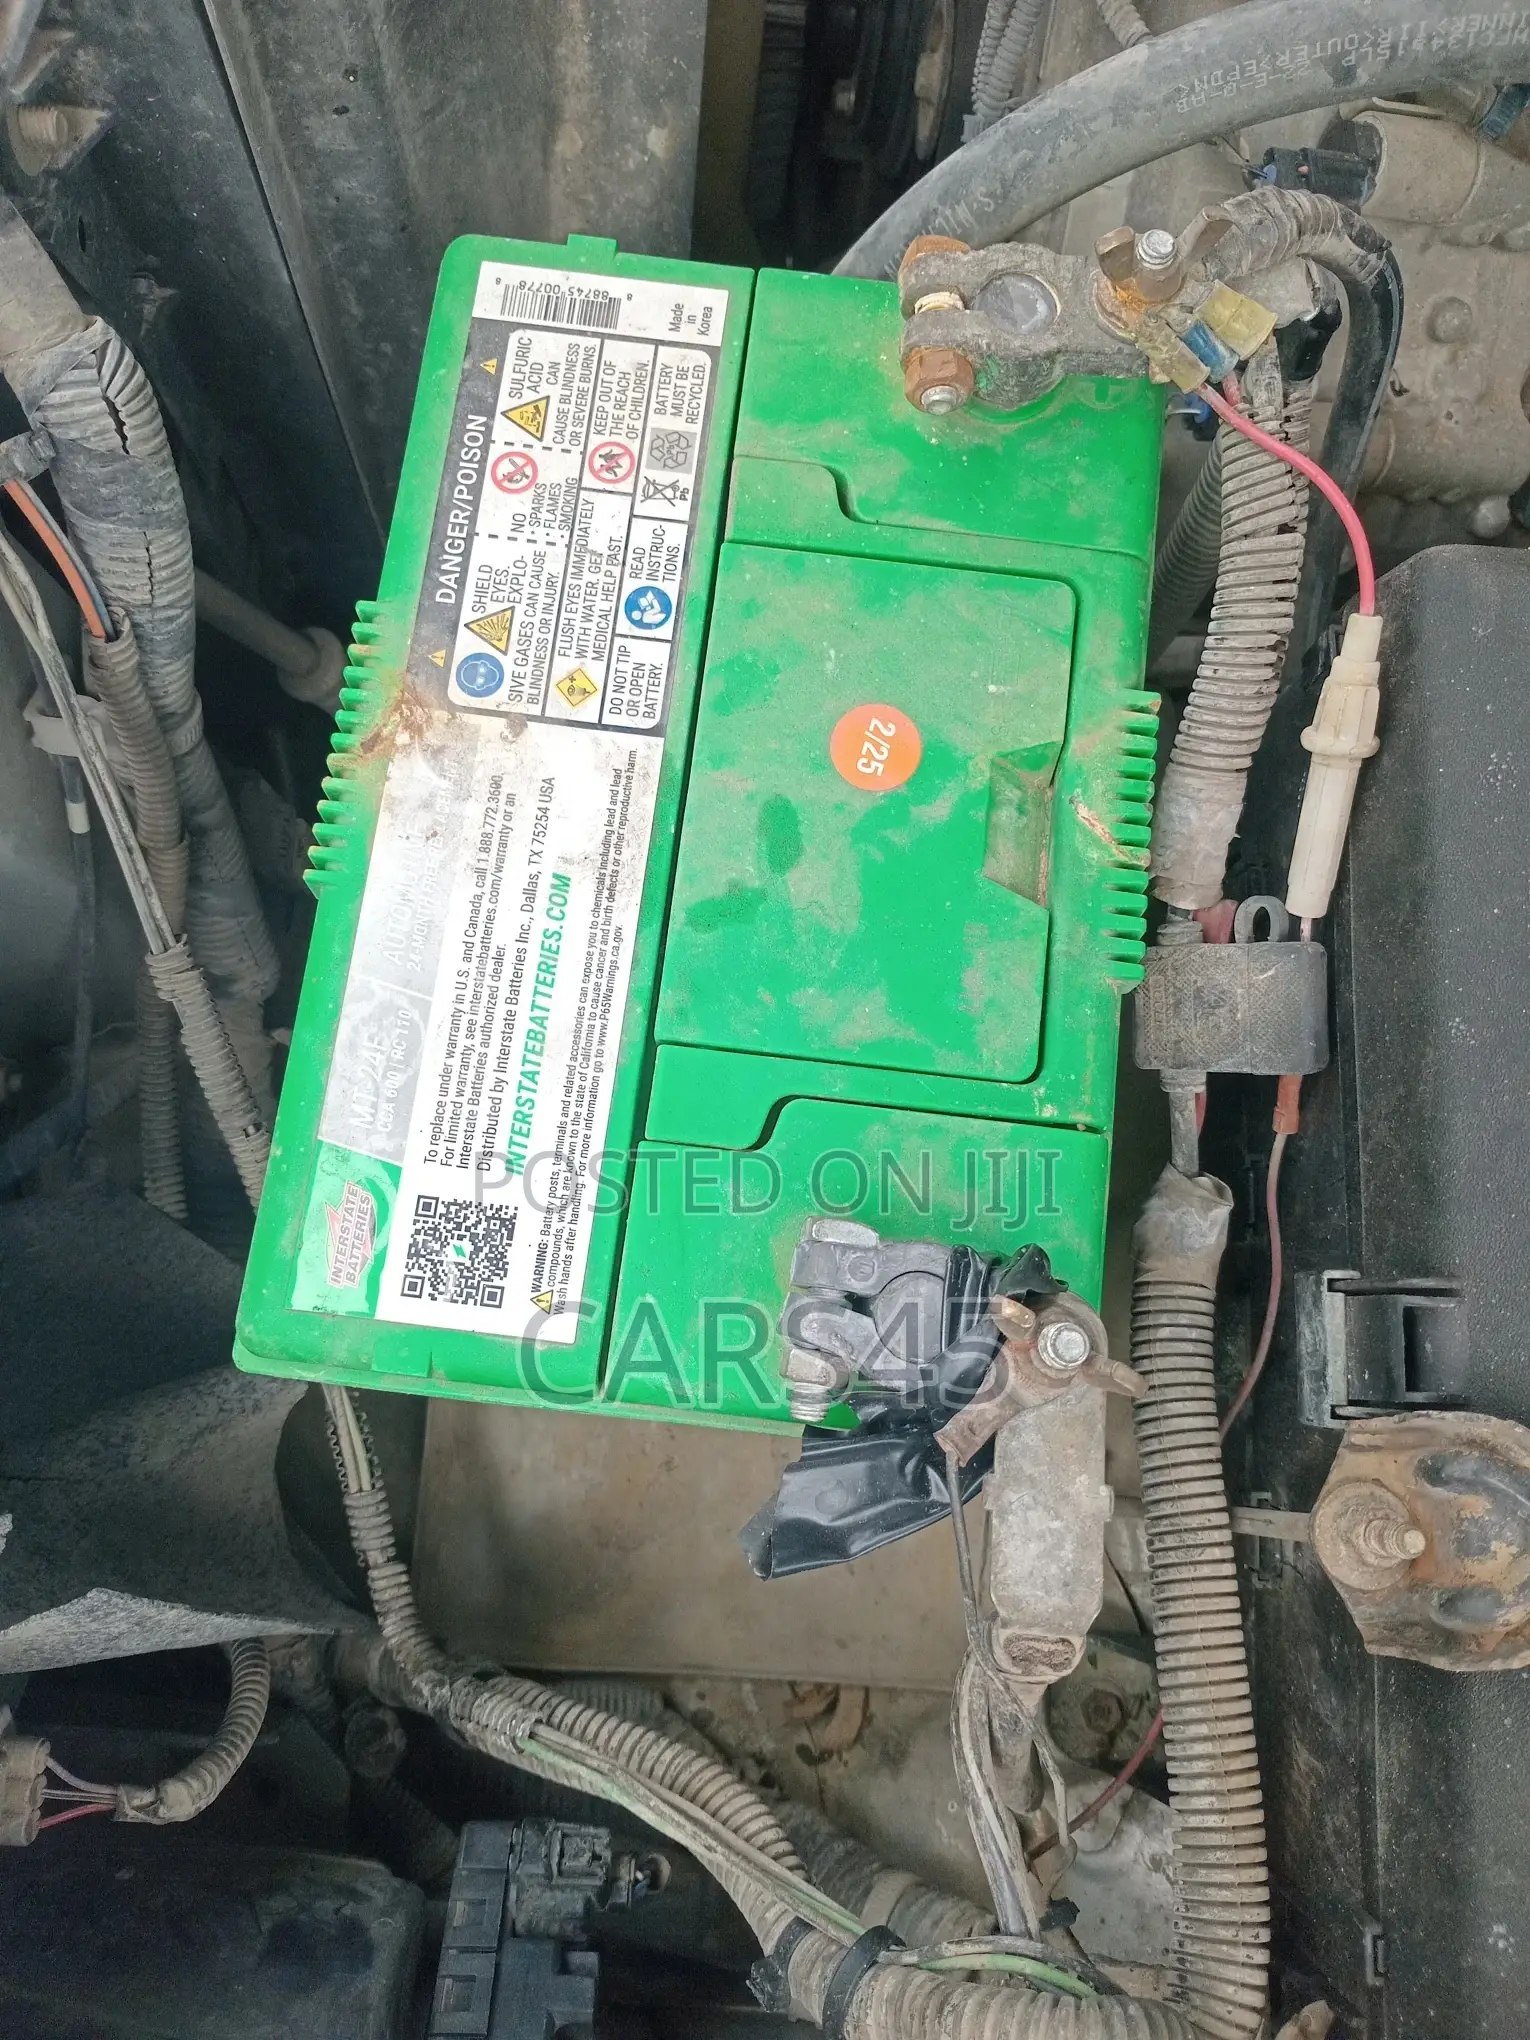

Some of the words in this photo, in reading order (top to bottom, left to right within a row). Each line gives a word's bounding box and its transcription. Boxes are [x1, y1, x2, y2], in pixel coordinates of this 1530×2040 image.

[517, 279, 561, 295] 00778
[566, 285, 609, 300] 88745
[667, 302, 685, 332] Made
[684, 313, 697, 324] in
[696, 305, 713, 336] Korea
[507, 336, 533, 399] SULFURIC
[525, 361, 544, 394] ACID
[545, 360, 561, 385] CAN
[558, 341, 581, 405] BLINDNESS
[578, 343, 597, 384] BURNS.
[601, 359, 617, 376] OF
[674, 364, 690, 381] BE
[597, 376, 614, 402] OUT
[612, 370, 632, 411] REACH
[627, 359, 650, 421] CHILDREN.
[653, 361, 674, 415] BATTERY
[669, 381, 687, 417] MUST
[684, 361, 707, 424] RECYCLED.
[571, 384, 590, 428] SEVERE
[592, 404, 609, 436] KEEP
[551, 406, 570, 444] CAUSE
[567, 429, 583, 447] OR
[608, 412, 625, 437] THE
[624, 422, 640, 440] OF
[434, 413, 488, 605] DANGER/POISON
[527, 480, 548, 527] SPARKS
[542, 481, 563, 529] FLAMES
[557, 475, 580, 533] SMOKING
[678, 486, 690, 501] Pb
[509, 512, 527, 533] NO
[569, 497, 595, 580] IMMEDIATELY
[527, 549, 547, 589] CAUSE
[628, 546, 646, 579] READ
[644, 523, 666, 581] INSTRUC-
[661, 542, 681, 583] TIONS.
[470, 563, 493, 614] SHIELD
[489, 565, 510, 603] EYES.
[506, 554, 528, 604] EXPLO-
[540, 571, 560, 615] INJURY.
[599, 568, 617, 602] HELP
[523, 591, 540, 618] CAN
[564, 582, 582, 614] EYES
[579, 577, 600, 623] WATER.
[537, 616, 553, 634] OR
[557, 616, 577, 657] FLUSH
[573, 625, 592, 659] WITH
[590, 605, 613, 662] MEDICAL
[513, 620, 535, 667] GASES
[615, 644, 631, 665] TIP
[507, 669, 527, 703] SIVE
[526, 636, 549, 705] BLINDNESS
[611, 666, 628, 694] NOT
[628, 661, 646, 696] OPEN
[608, 696, 624, 715] DO
[625, 698, 641, 717] OR
[641, 662, 663, 719] BATTERY.
[623, 745, 637, 774] harm.
[856, 717, 896, 777] 2/25
[537, 776, 555, 803] USA
[609, 767, 622, 787] lead
[504, 792, 516, 807] an
[608, 788, 619, 806] and
[617, 774, 634, 830] reproductive
[502, 808, 513, 822] or
[531, 806, 550, 845] 75254
[603, 807, 616, 827] lead
[527, 848, 543, 866] TX
[597, 828, 615, 870] including
[612, 830, 625, 856] other
[473, 866, 488, 888] call
[611, 855, 621, 867] or
[519, 870, 542, 912] Dallas,
[590, 870, 607, 918] chemicals
[604, 868, 620, 903] defects
[463, 890, 486, 938] Canada,
[465, 822, 514, 1016] interstatebatteries.com/warranty
[514, 916, 534, 943] Inc.,
[588, 919, 599, 929] to
[600, 904, 613, 926] birth
[461, 939, 475, 963] and
[587, 931, 597, 949] you
[599, 927, 610, 946] and
[453, 966, 470, 990] U.S.
[487, 943, 506, 982] dealer.
[504, 946, 527, 1005] Batteries
[581, 949, 594, 984] expose
[594, 946, 607, 979] cancer
[451, 992, 466, 1004] in
[578, 985, 589, 1003] can
[590, 980, 602, 1009] cause
[444, 1006, 466, 1059] warranty
[464, 1017, 478, 1040] see
[479, 984, 499, 1048] authorized
[504, 872, 572, 1175] INTERSTATEBATTERIES.COM
[587, 1010, 597, 1021] to
[492, 1008, 517, 1073] Interstate
[569, 1005, 586, 1062] accessories
[578, 1023, 596, 1069] California
[593, 1060, 604, 1073] go
[594, 1047, 604, 1058] to
[377, 1101, 396, 1132] CCA
[390, 1038, 407, 1060] RC
[437, 1060, 453, 1097] under
[454, 1043, 476, 1101] warranty,
[466, 1050, 488, 1106] Batteries
[488, 1076, 509, 1093] by
[562, 1063, 576, 1098] related
[577, 1070, 588, 1082] of
[560, 1099, 571, 1118] and
[574, 1083, 586, 1108] state
[582, 1074, 600, 1131] information
[429, 1099, 447, 1146] replace
[442, 1099, 469, 1143] limited
[475, 1095, 502, 1171] Distributed
[568, 1128, 579, 1138] to
[569, 1110, 582, 1126] the
[455, 1108, 478, 1169] Interstate
[551, 1120, 568, 1165] terminals
[579, 1132, 591, 1159] more
[422, 1148, 442, 1165] To
[439, 1145, 458, 1168] For
[562, 1140, 577, 1176] known
[574, 1160, 587, 1177] For
[547, 1168, 562, 1199] posts,
[561, 1175, 573, 1191] are
[539, 1200, 557, 1236] Battery
[555, 1193, 572, 1223] which
[566, 1181, 586, 1225] handling.
[330, 1185, 359, 1284] INTERSTATE
[345, 1194, 371, 1283] BATTERIES
[563, 1226, 577, 1251] after
[530, 1238, 549, 1293] WARNING:
[546, 1225, 566, 1287] compounds,
[557, 1253, 573, 1285] hands
[552, 1286, 568, 1315] Wash
